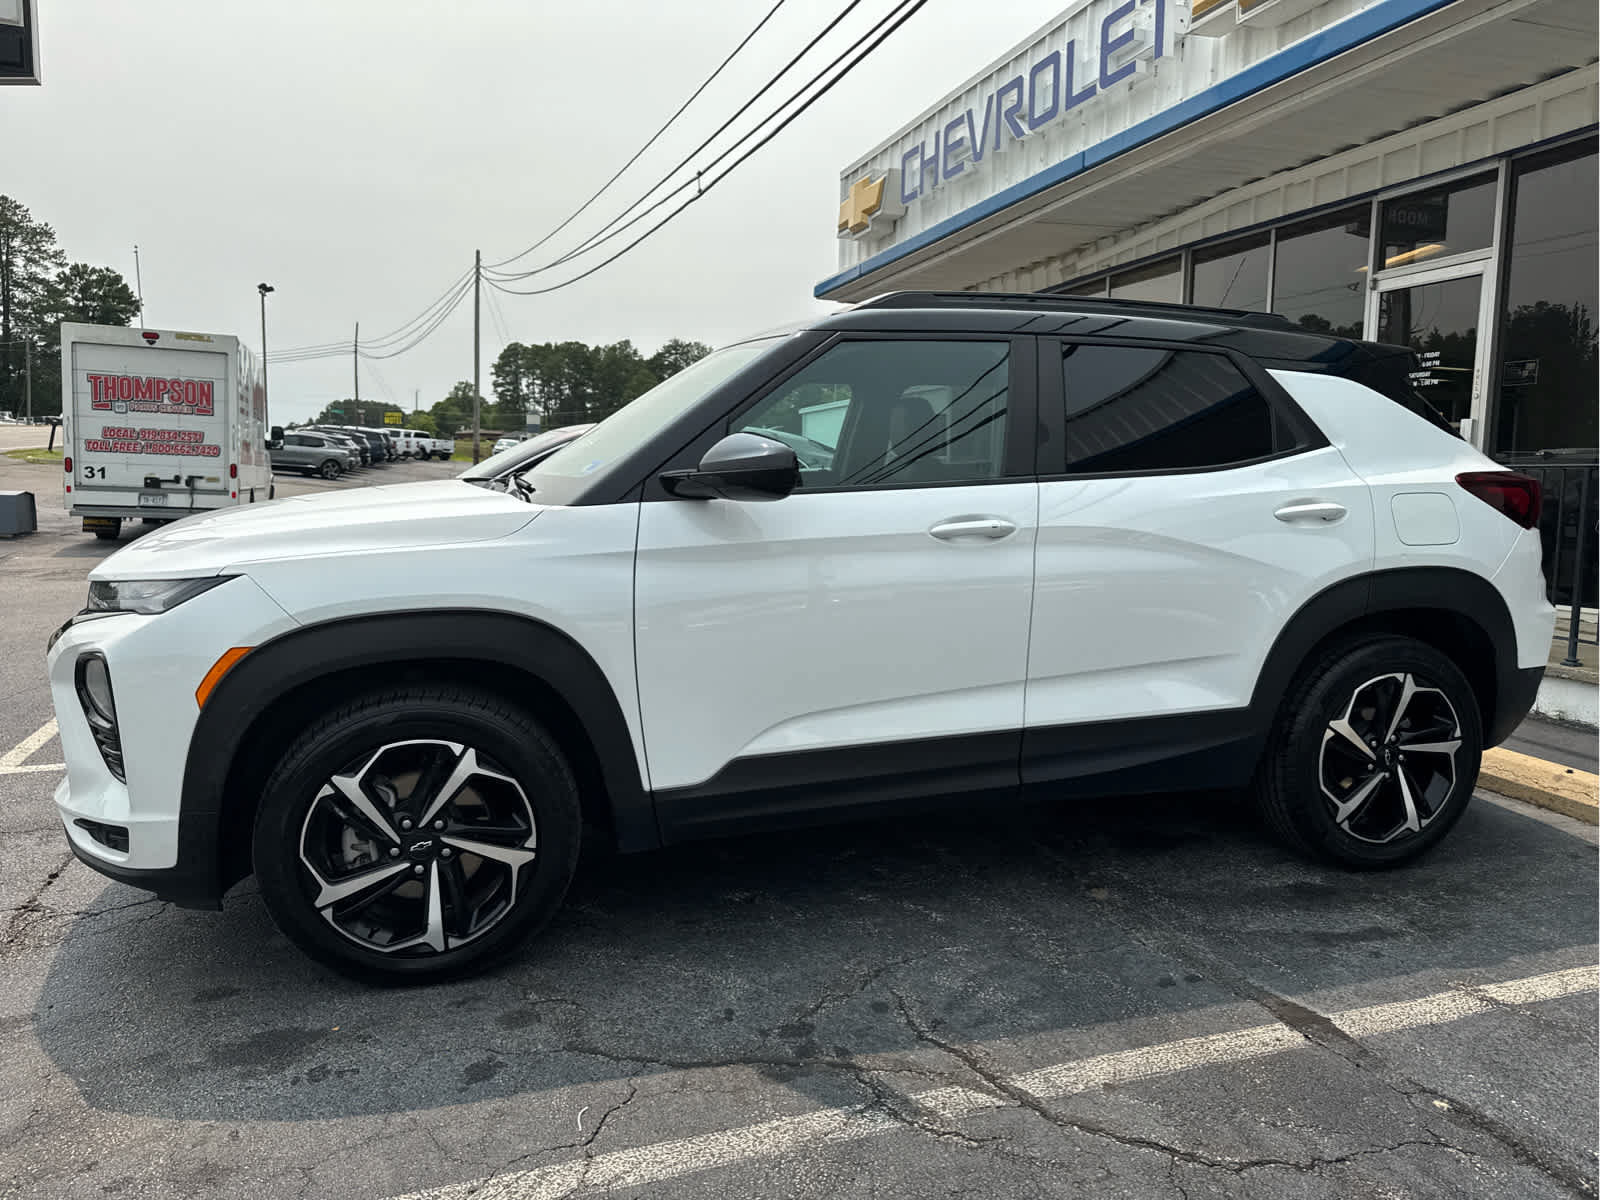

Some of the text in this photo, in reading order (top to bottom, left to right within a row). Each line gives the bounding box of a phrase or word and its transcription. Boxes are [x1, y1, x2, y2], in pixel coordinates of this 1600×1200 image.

[901, 0, 1165, 204] CHEVROLET
[87, 373, 214, 410] THOMPSON
[102, 427, 139, 440] LOCAL:
[85, 440, 111, 452] TOLL
[112, 440, 143, 453] FREE:
[84, 466, 106, 480] 31
